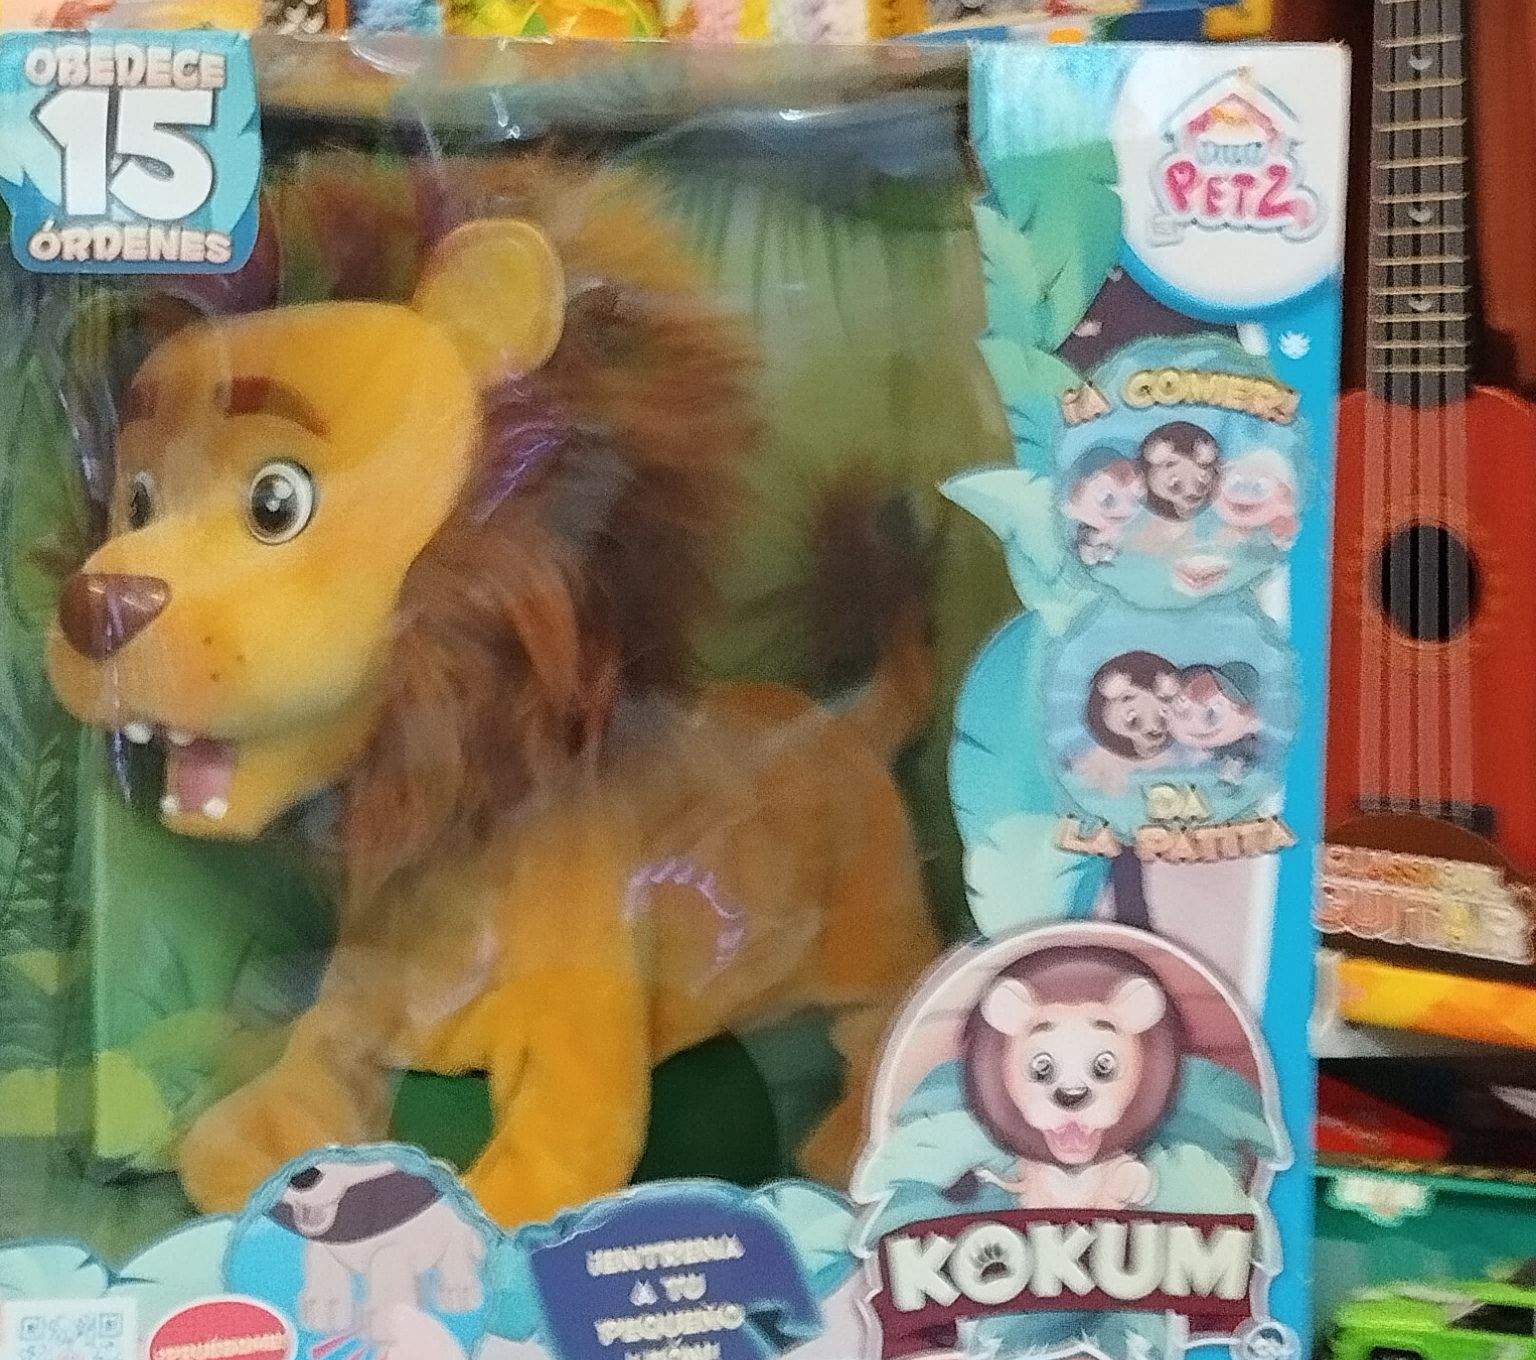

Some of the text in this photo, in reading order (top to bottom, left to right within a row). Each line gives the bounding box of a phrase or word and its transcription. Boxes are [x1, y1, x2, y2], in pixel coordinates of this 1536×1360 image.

[25, 44, 226, 88] OBEDECE
[35, 86, 214, 221] 15
[27, 220, 231, 263] ÓRDENES
[887, 1217, 1252, 1313] KOKUM
